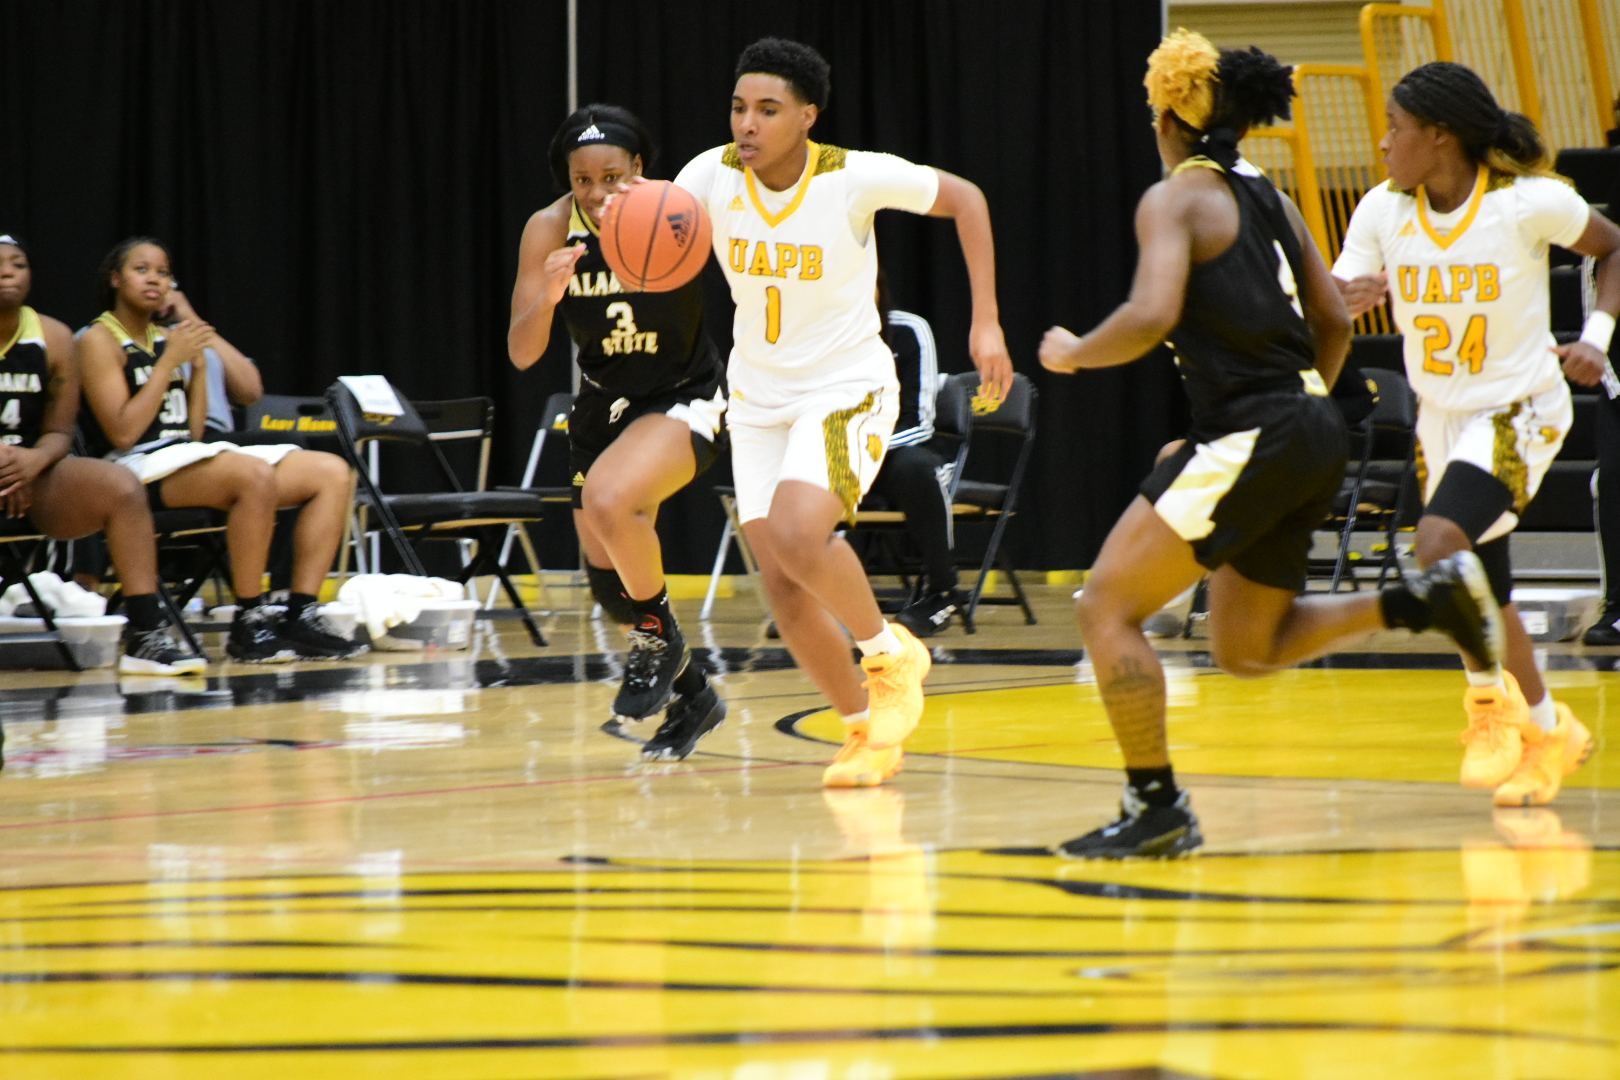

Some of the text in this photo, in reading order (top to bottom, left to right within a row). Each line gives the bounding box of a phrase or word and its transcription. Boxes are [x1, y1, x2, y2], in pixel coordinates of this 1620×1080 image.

[728, 237, 823, 281] UAPB
[1397, 263, 1501, 303] UAPB
[606, 301, 637, 337] 3
[765, 286, 781, 344] 1
[1413, 313, 1487, 376] 24
[159, 388, 188, 425] 30
